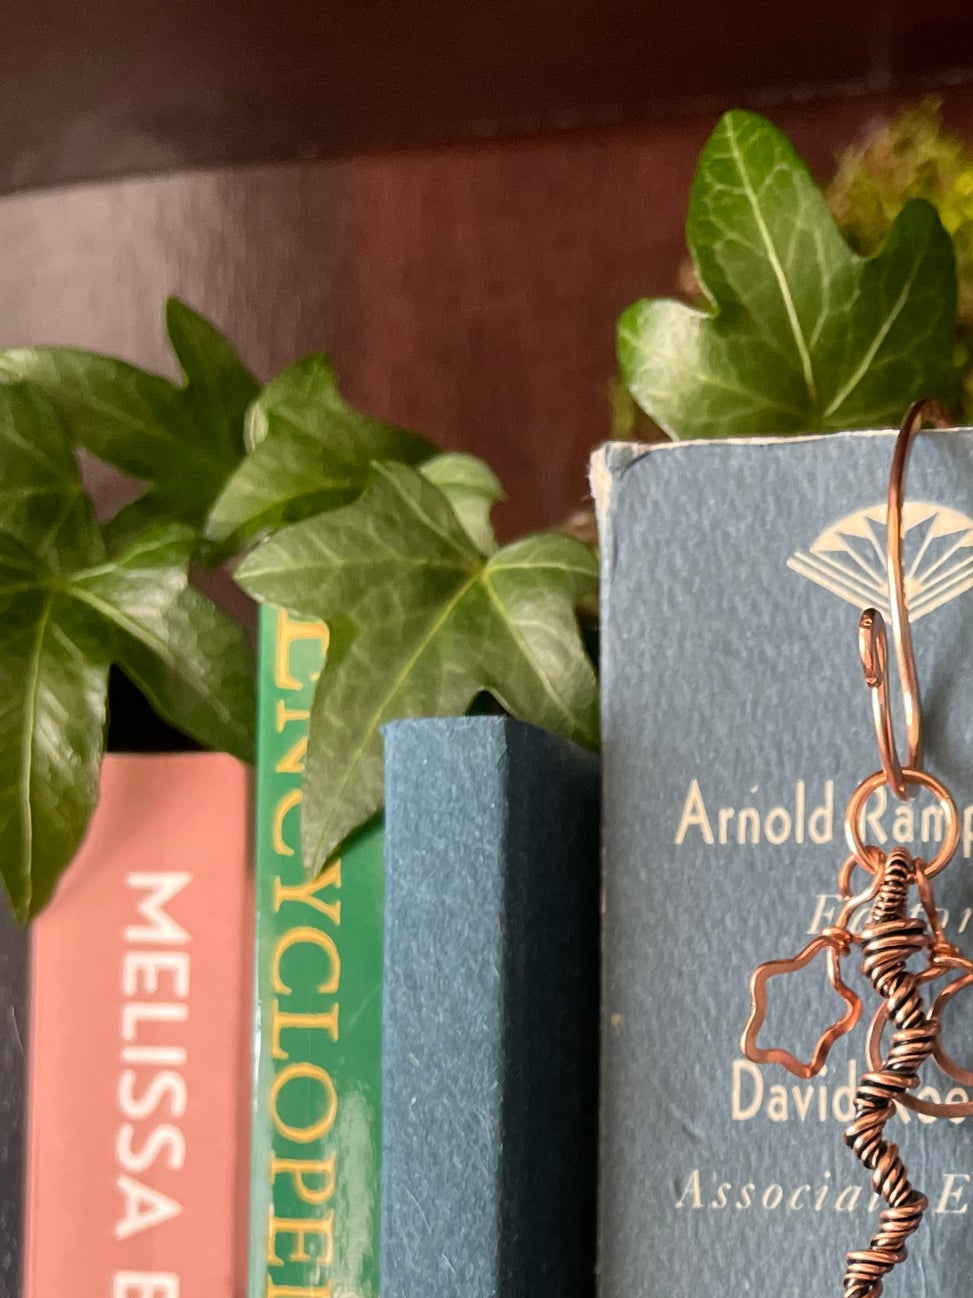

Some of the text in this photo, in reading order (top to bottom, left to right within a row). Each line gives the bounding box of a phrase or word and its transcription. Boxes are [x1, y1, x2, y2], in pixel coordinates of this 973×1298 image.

[675, 778, 834, 844] Arnold
[113, 871, 193, 1239] MELISSA
[731, 1058, 857, 1122] David
[675, 1168, 883, 1213] Associa
